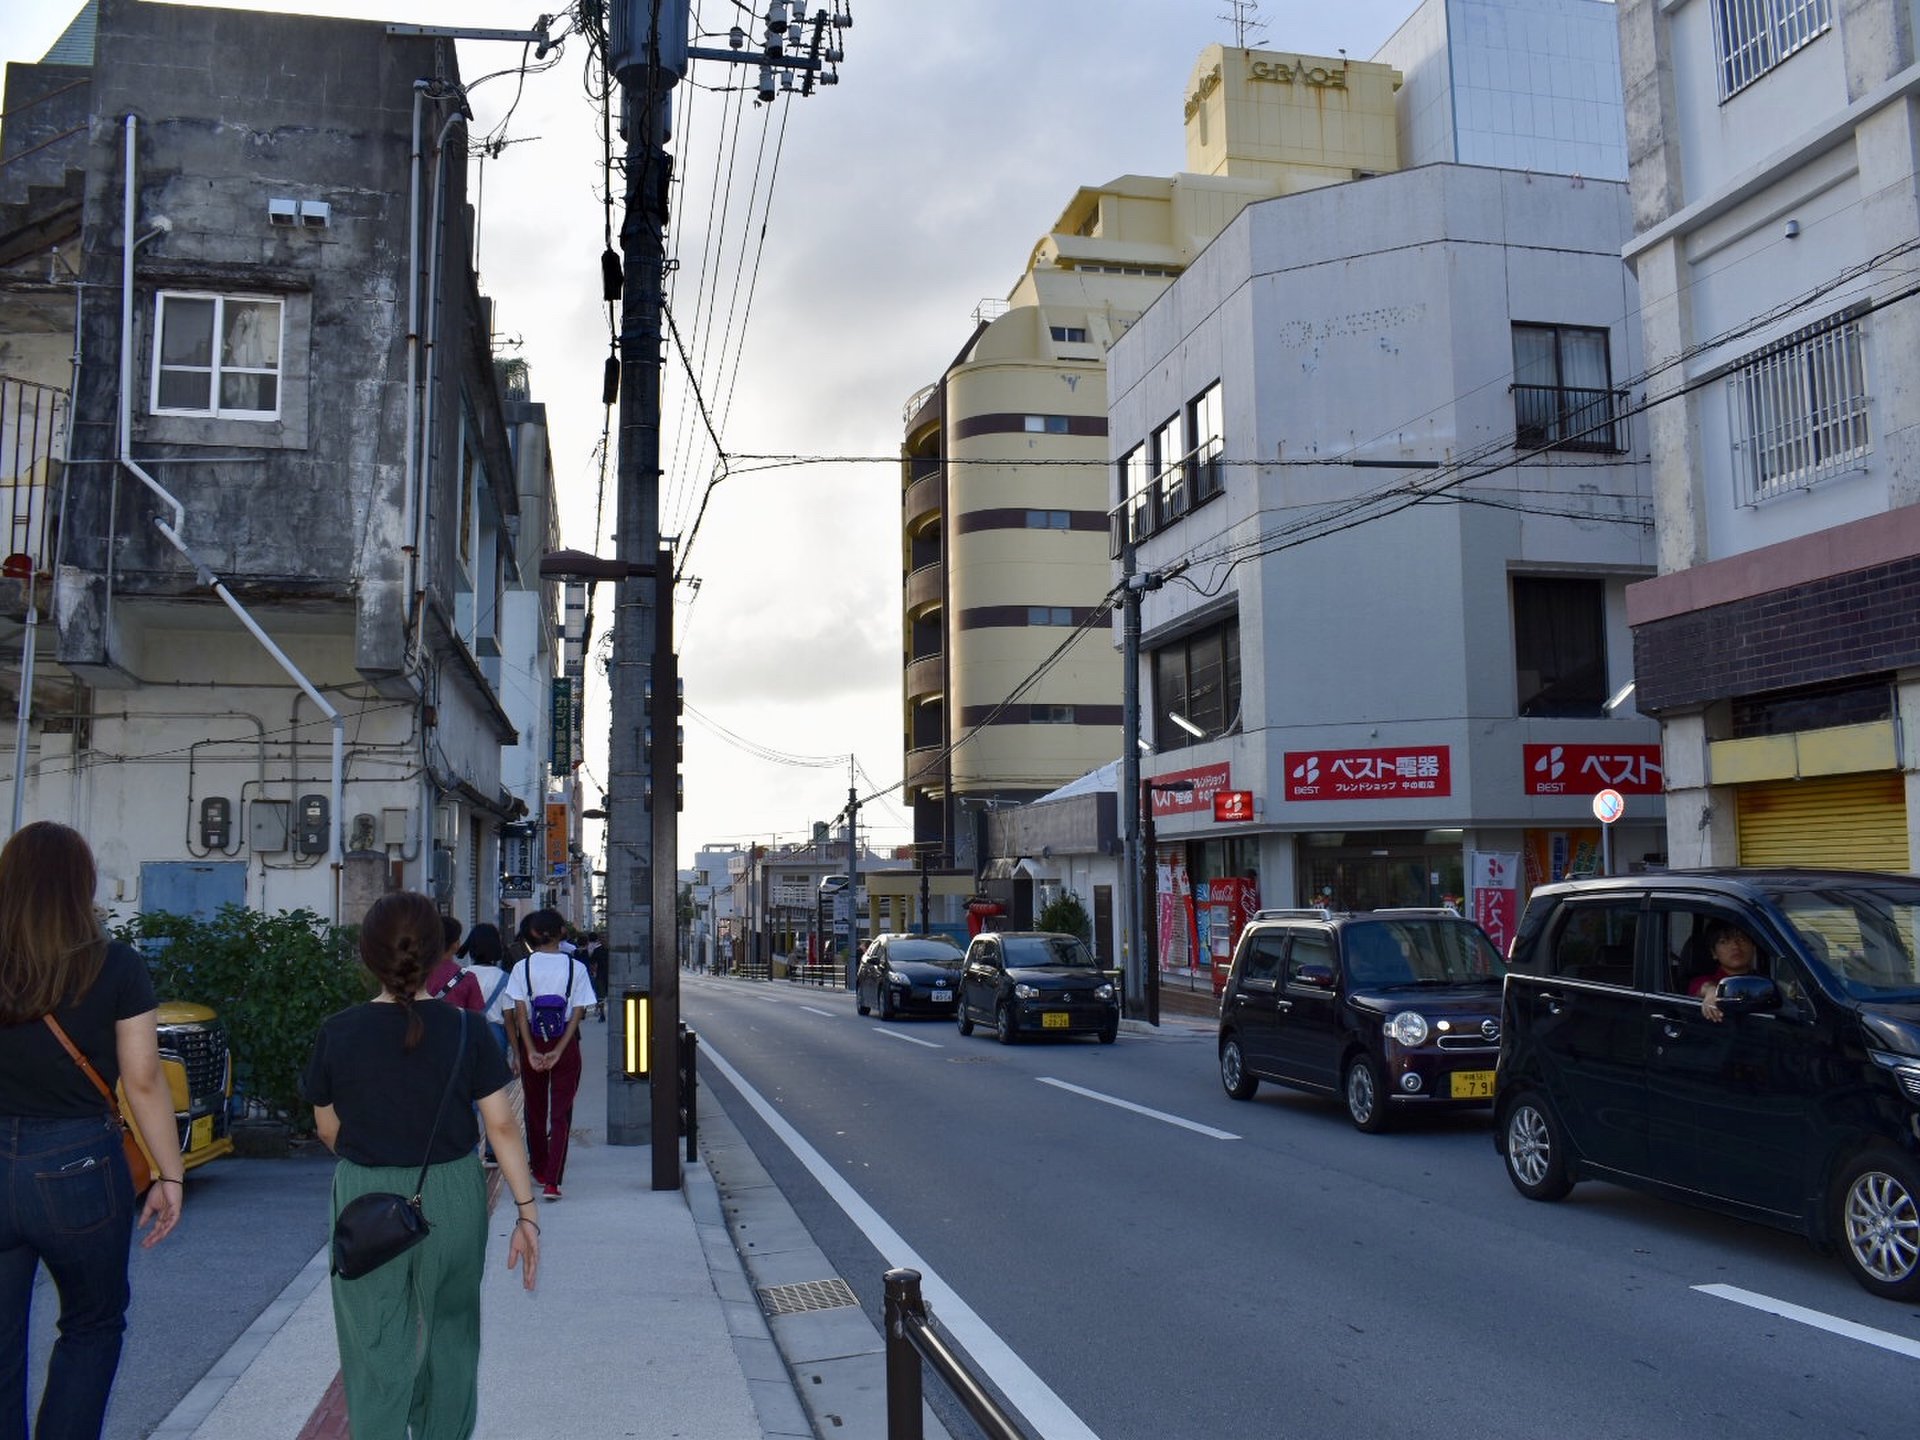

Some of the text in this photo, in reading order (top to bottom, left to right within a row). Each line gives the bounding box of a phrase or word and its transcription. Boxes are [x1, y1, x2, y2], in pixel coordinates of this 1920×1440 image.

[1330, 755, 1439, 780] ベスト電器
[1580, 755, 1661, 784] ベスト
[1294, 786, 1321, 795] BEST
[1335, 780, 1436, 792] フレンドショップ 中の町店
[1536, 782, 1566, 793] BEST
